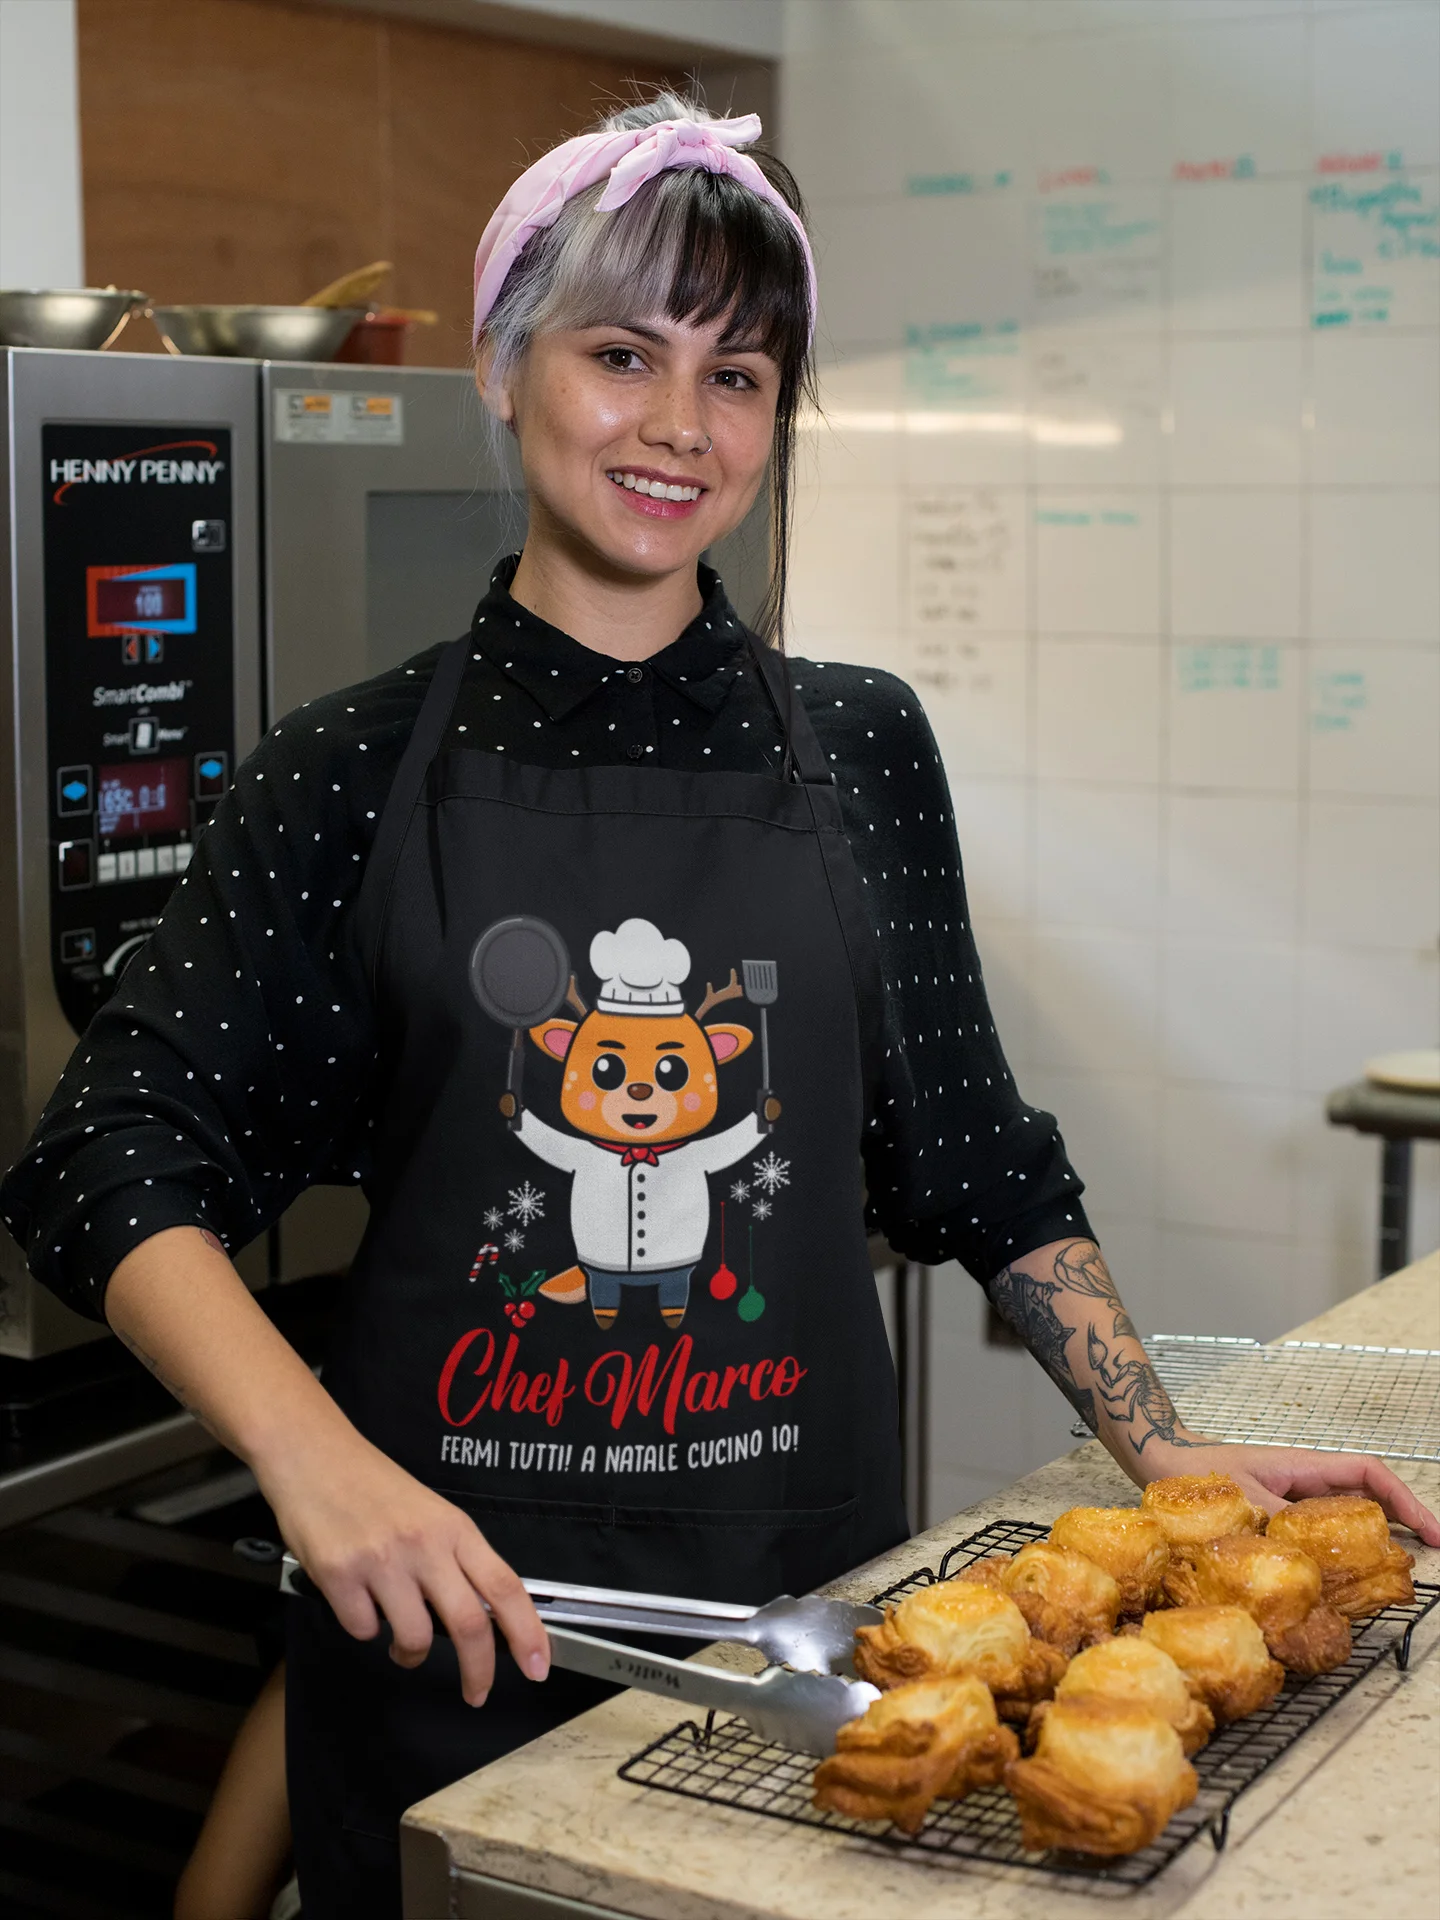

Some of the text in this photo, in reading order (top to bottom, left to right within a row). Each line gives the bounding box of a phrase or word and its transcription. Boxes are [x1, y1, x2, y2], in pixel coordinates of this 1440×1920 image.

[50, 459, 221, 485] HENNY PENNY
[92, 680, 186, 707] SmartCombi
[437, 1327, 809, 1435] Chef Marco
[440, 1423, 800, 1474] FERMI TUTTI! A NATALE CUCINO IO!
